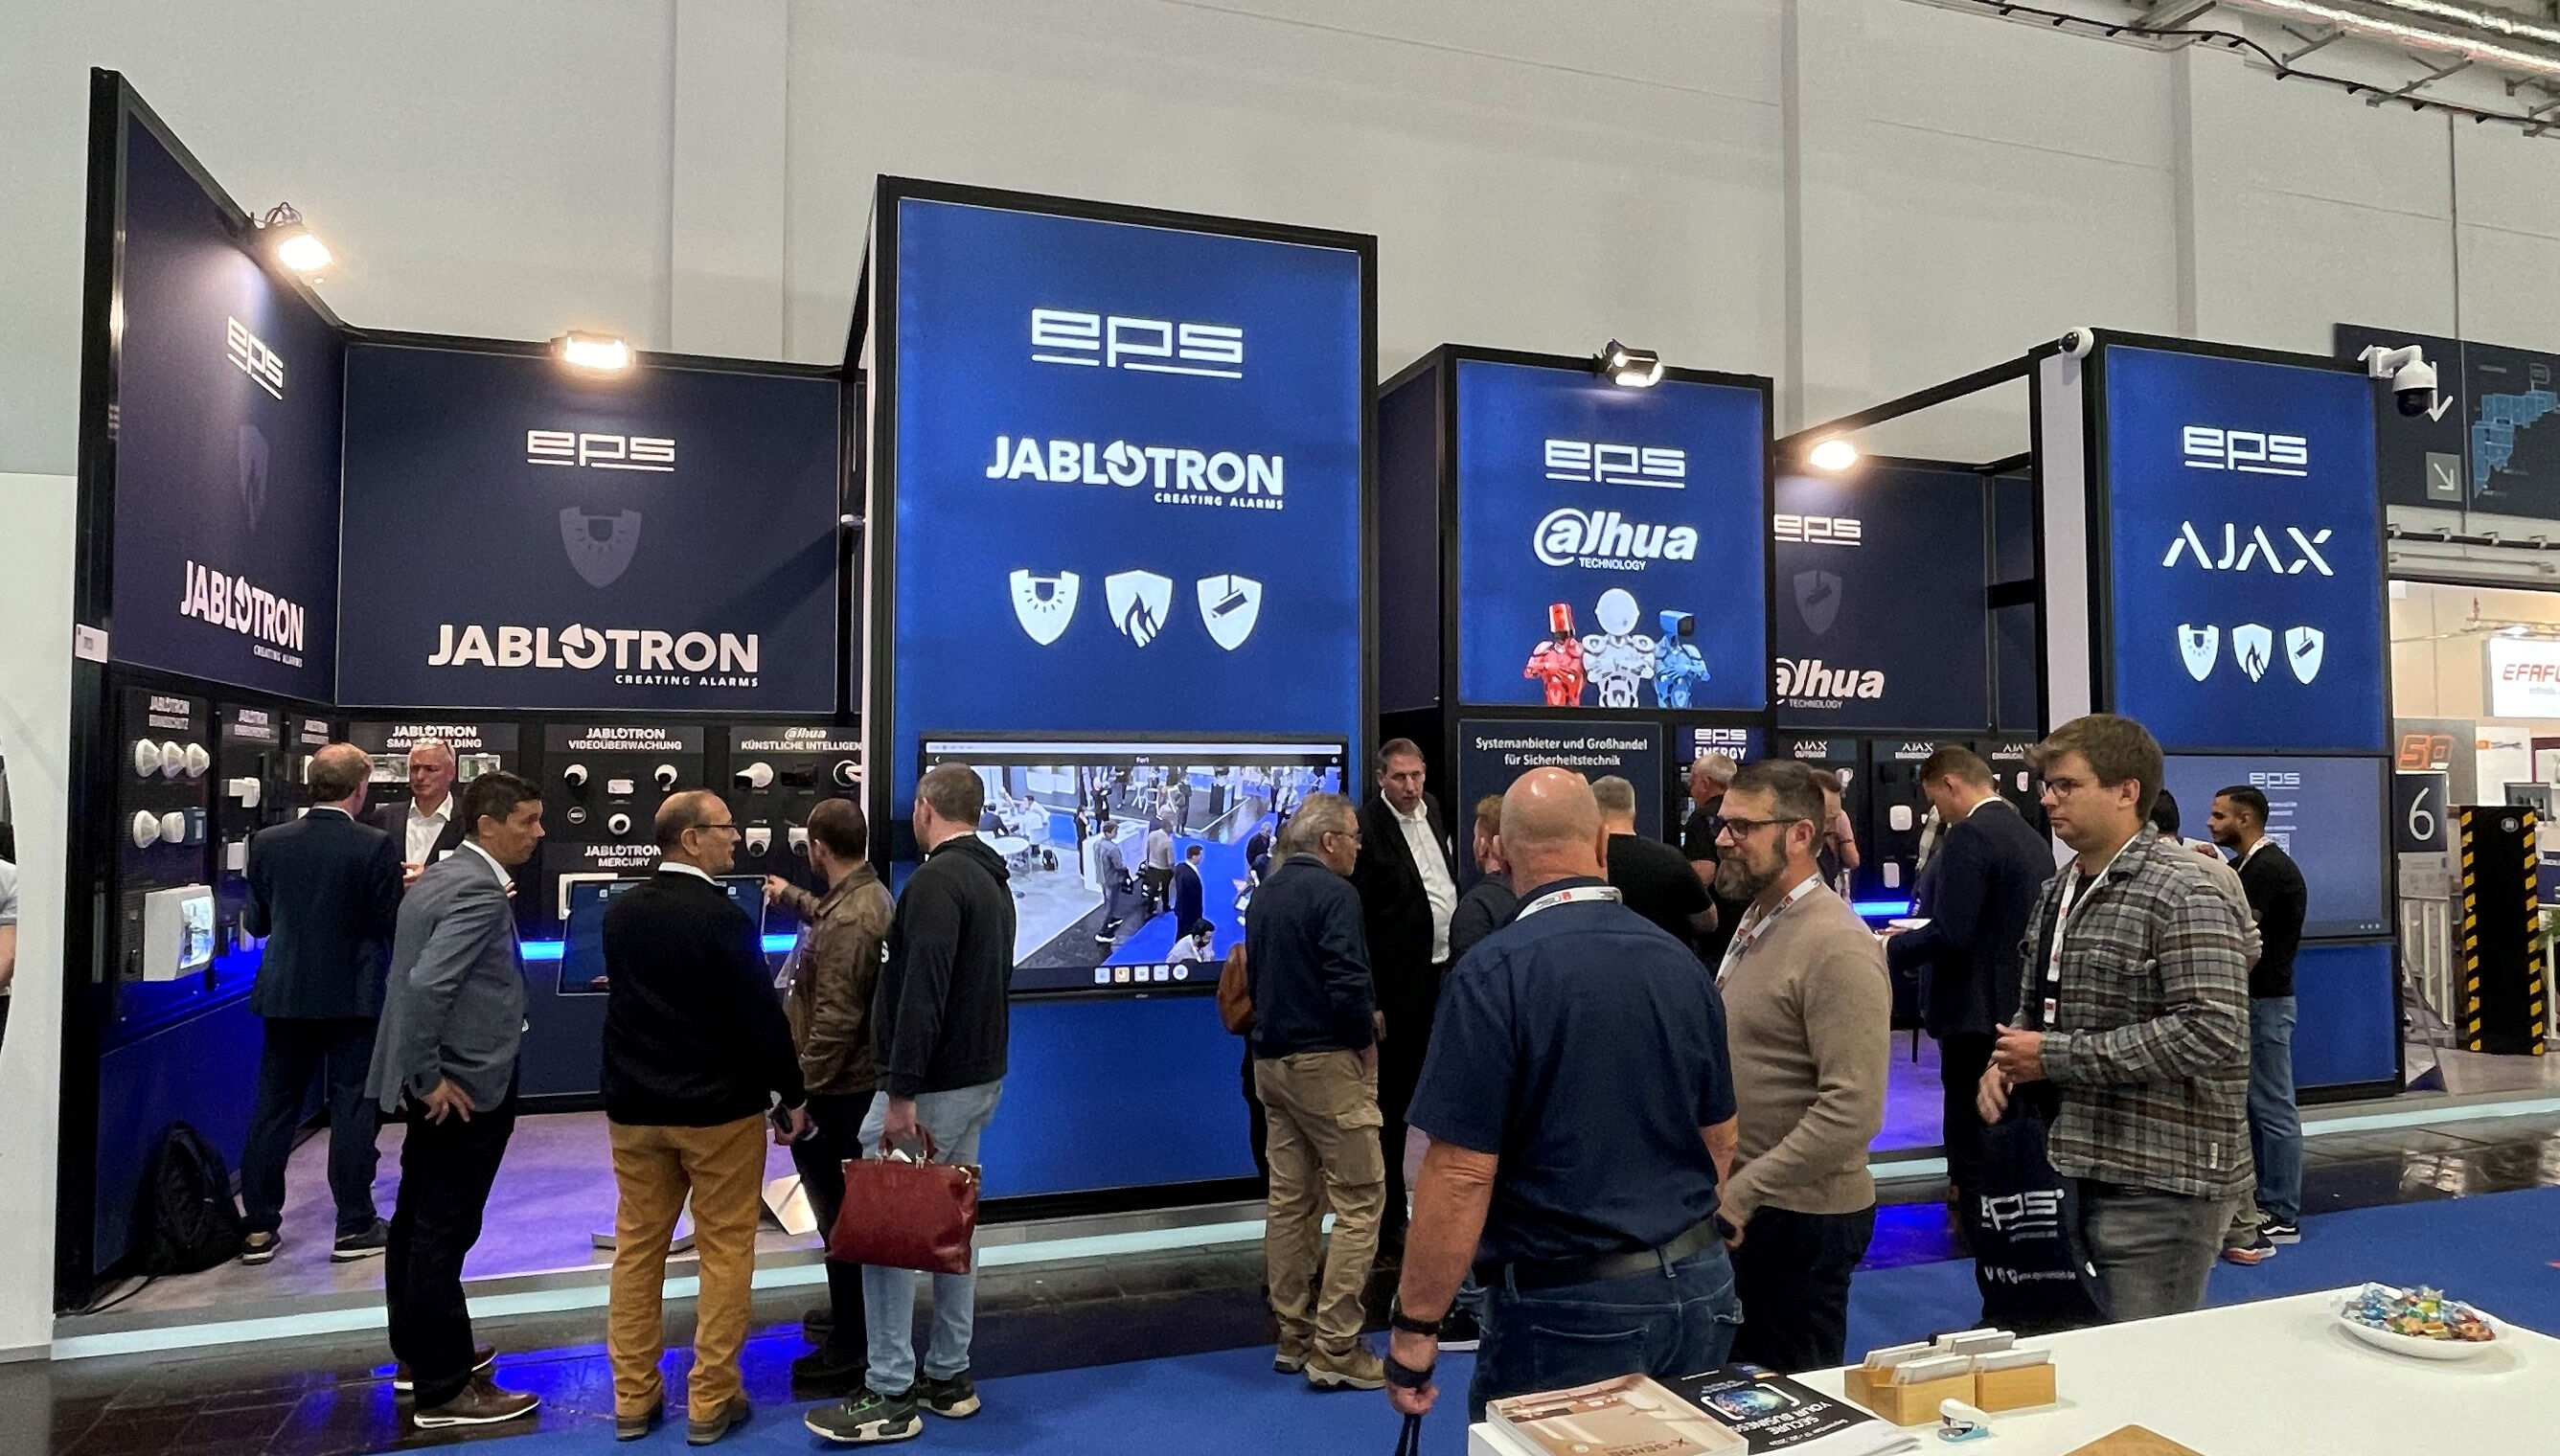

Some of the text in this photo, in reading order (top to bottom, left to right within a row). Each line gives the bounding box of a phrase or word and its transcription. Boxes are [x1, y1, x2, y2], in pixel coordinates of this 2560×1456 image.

[1031, 307, 1244, 379] eps
[228, 316, 285, 400] eps
[527, 429, 675, 472] eps
[2183, 425, 2308, 477] eps
[985, 435, 1284, 496] JABLOTRON
[1544, 438, 1686, 489] eps
[1154, 492, 1284, 511] CREATING ALARMS
[1773, 513, 1863, 546] eps
[2161, 520, 2335, 577] AJAX
[1579, 557, 1647, 572] TECHNOLOGY
[180, 559, 305, 652] JABLOTRON
[427, 623, 760, 673] JABLOTRON
[614, 674, 760, 689] CREATING ALARMS
[1789, 698, 1843, 710] TECHNOLOGY
[392, 724, 477, 738] JABLOTRON
[586, 727, 666, 739] JABLOTRON
[1694, 728, 1747, 745] eps
[568, 739, 683, 751] VIDEOÜBERWACHUNG
[741, 739, 862, 751] KÜNSTLICHE INTELLIGEN
[1475, 737, 1648, 751] Systemanbieter und Großhandel
[1793, 740, 1828, 751] AJAX
[1902, 741, 1934, 752] AJAX
[1504, 754, 1621, 766] für Sicherheitstechnik
[2249, 772, 2300, 789] eps
[2408, 786, 2435, 841] 6
[583, 844, 662, 857] JABLOTRON
[598, 856, 651, 868] MERCURY
[1764, 1414, 1820, 1436] SECURE
